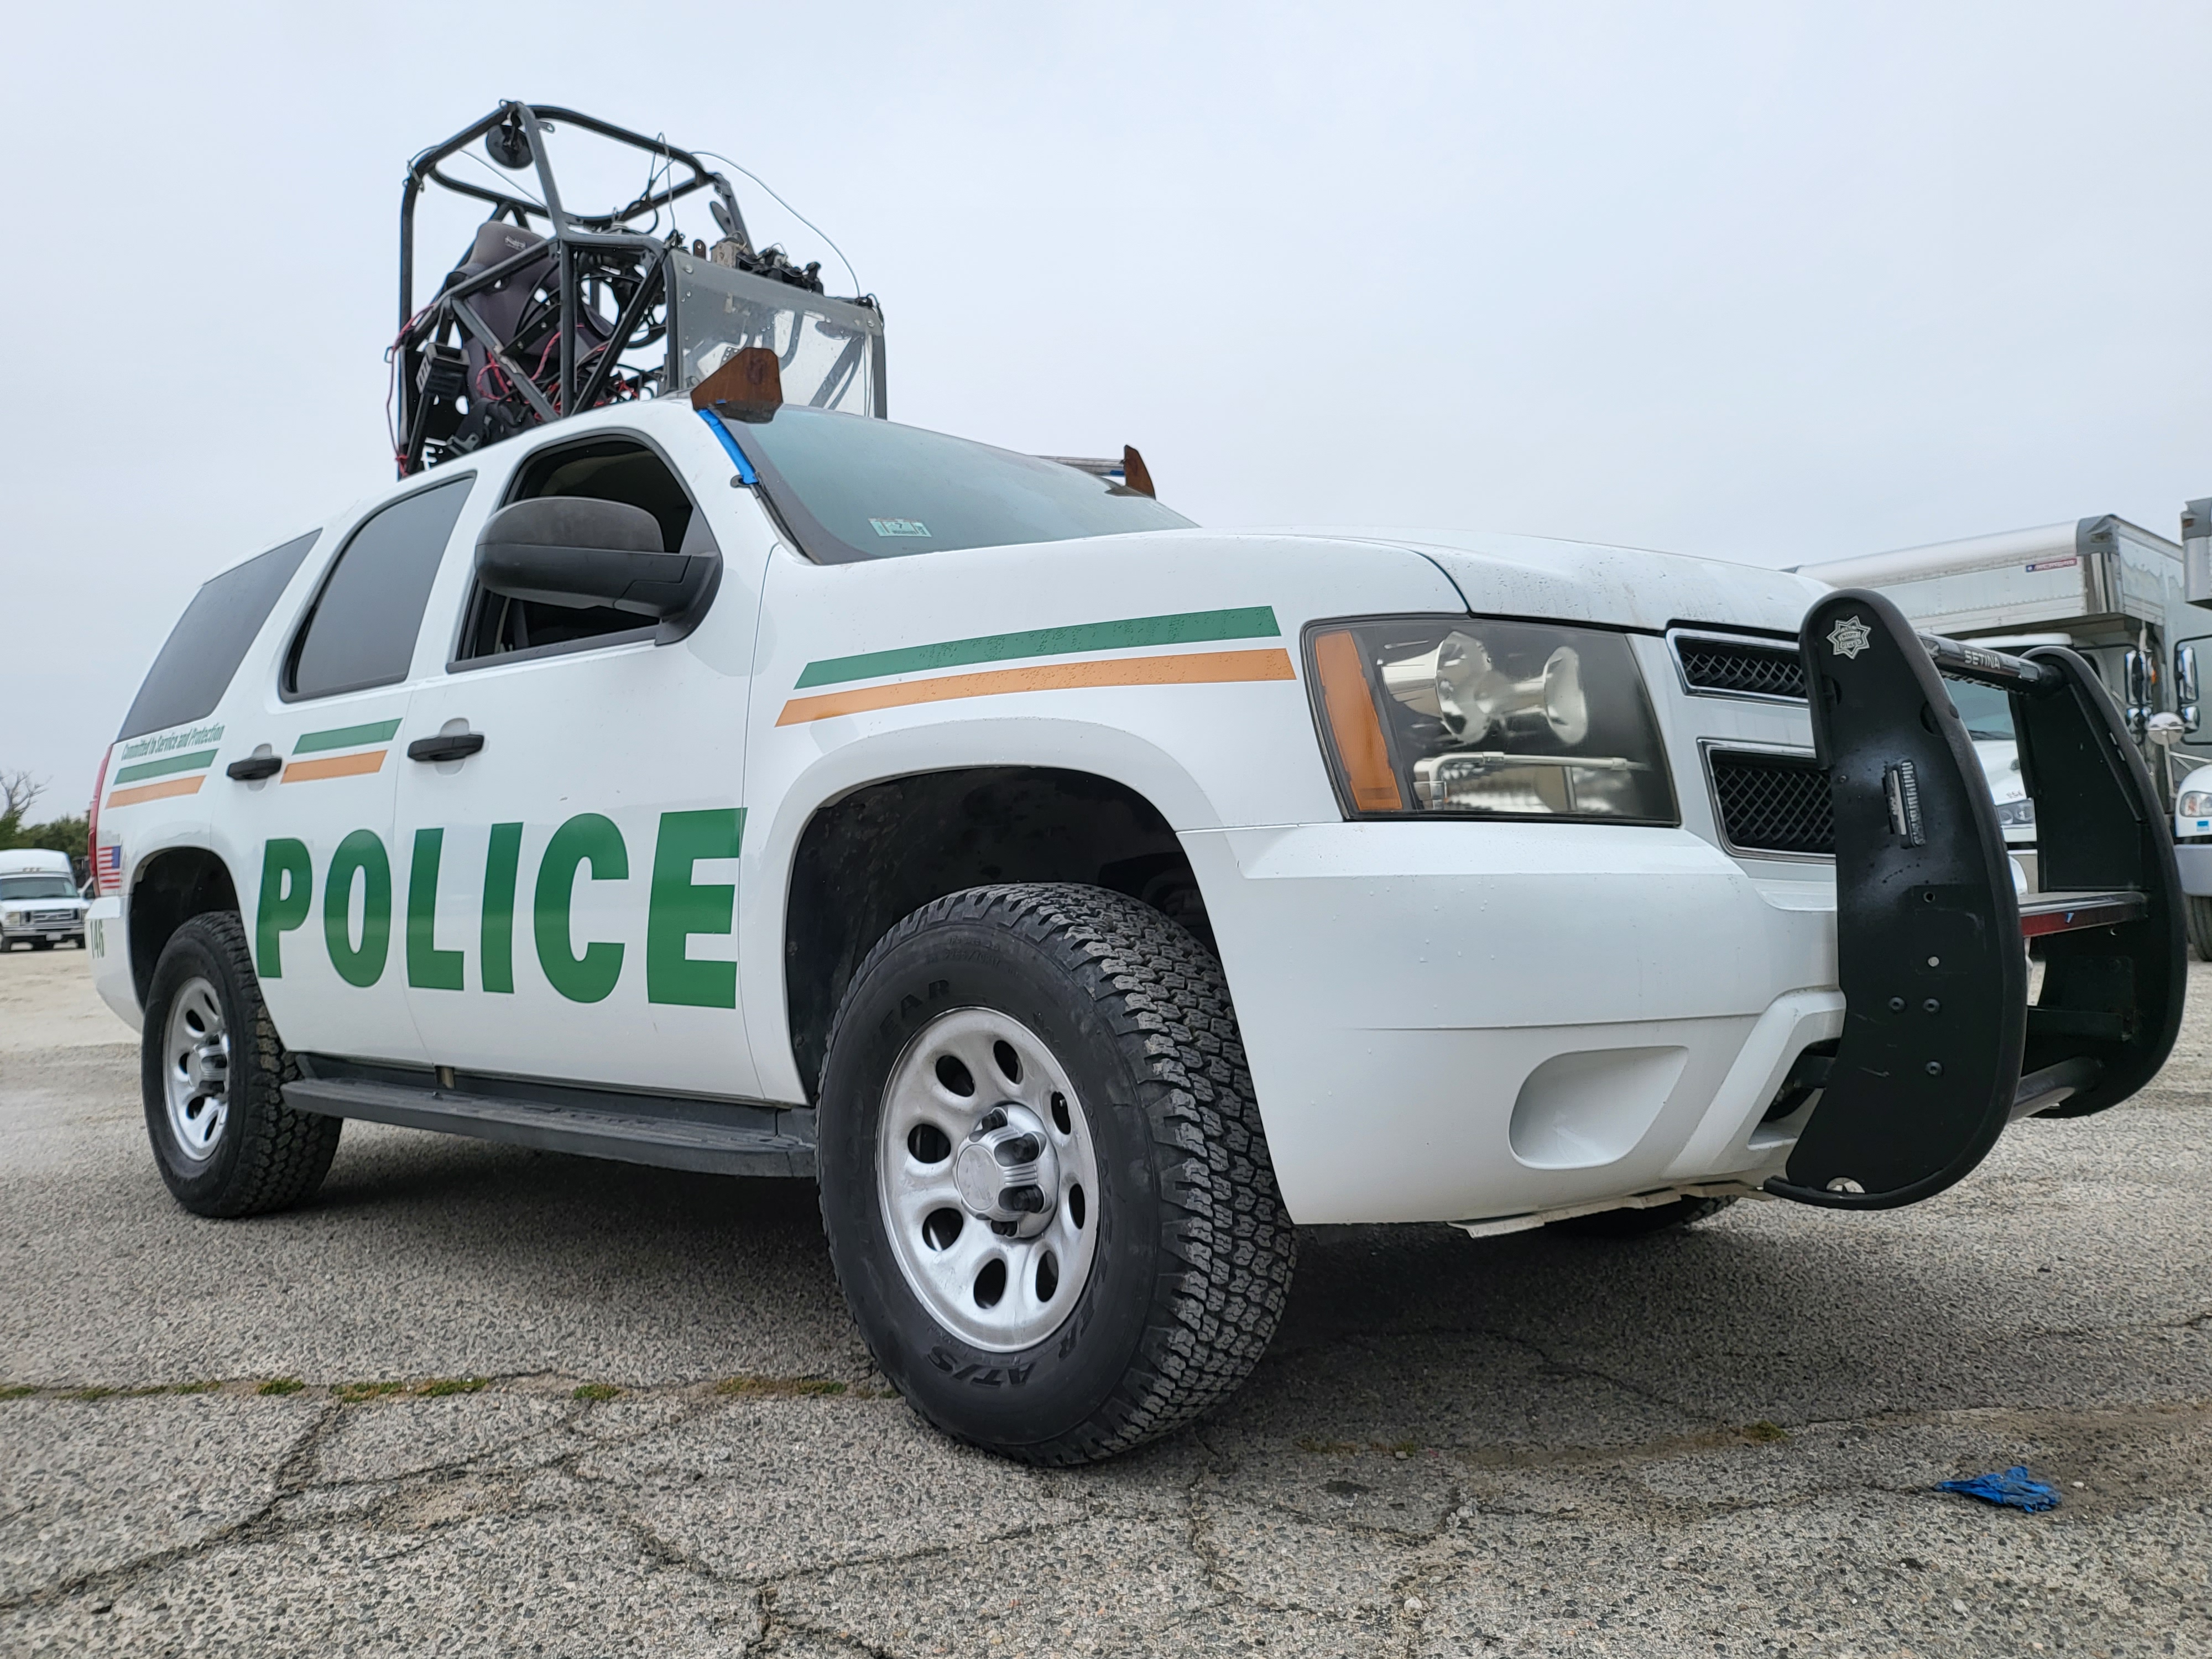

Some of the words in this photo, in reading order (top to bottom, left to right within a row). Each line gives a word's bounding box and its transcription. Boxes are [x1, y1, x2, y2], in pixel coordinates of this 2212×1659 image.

[1964, 649, 2001, 670] SETINA
[154, 732, 179, 754] Service
[176, 727, 193, 749] and
[187, 723, 225, 748] Protection
[256, 807, 748, 1009] POLICE
[927, 1344, 1037, 1386] AT/S
